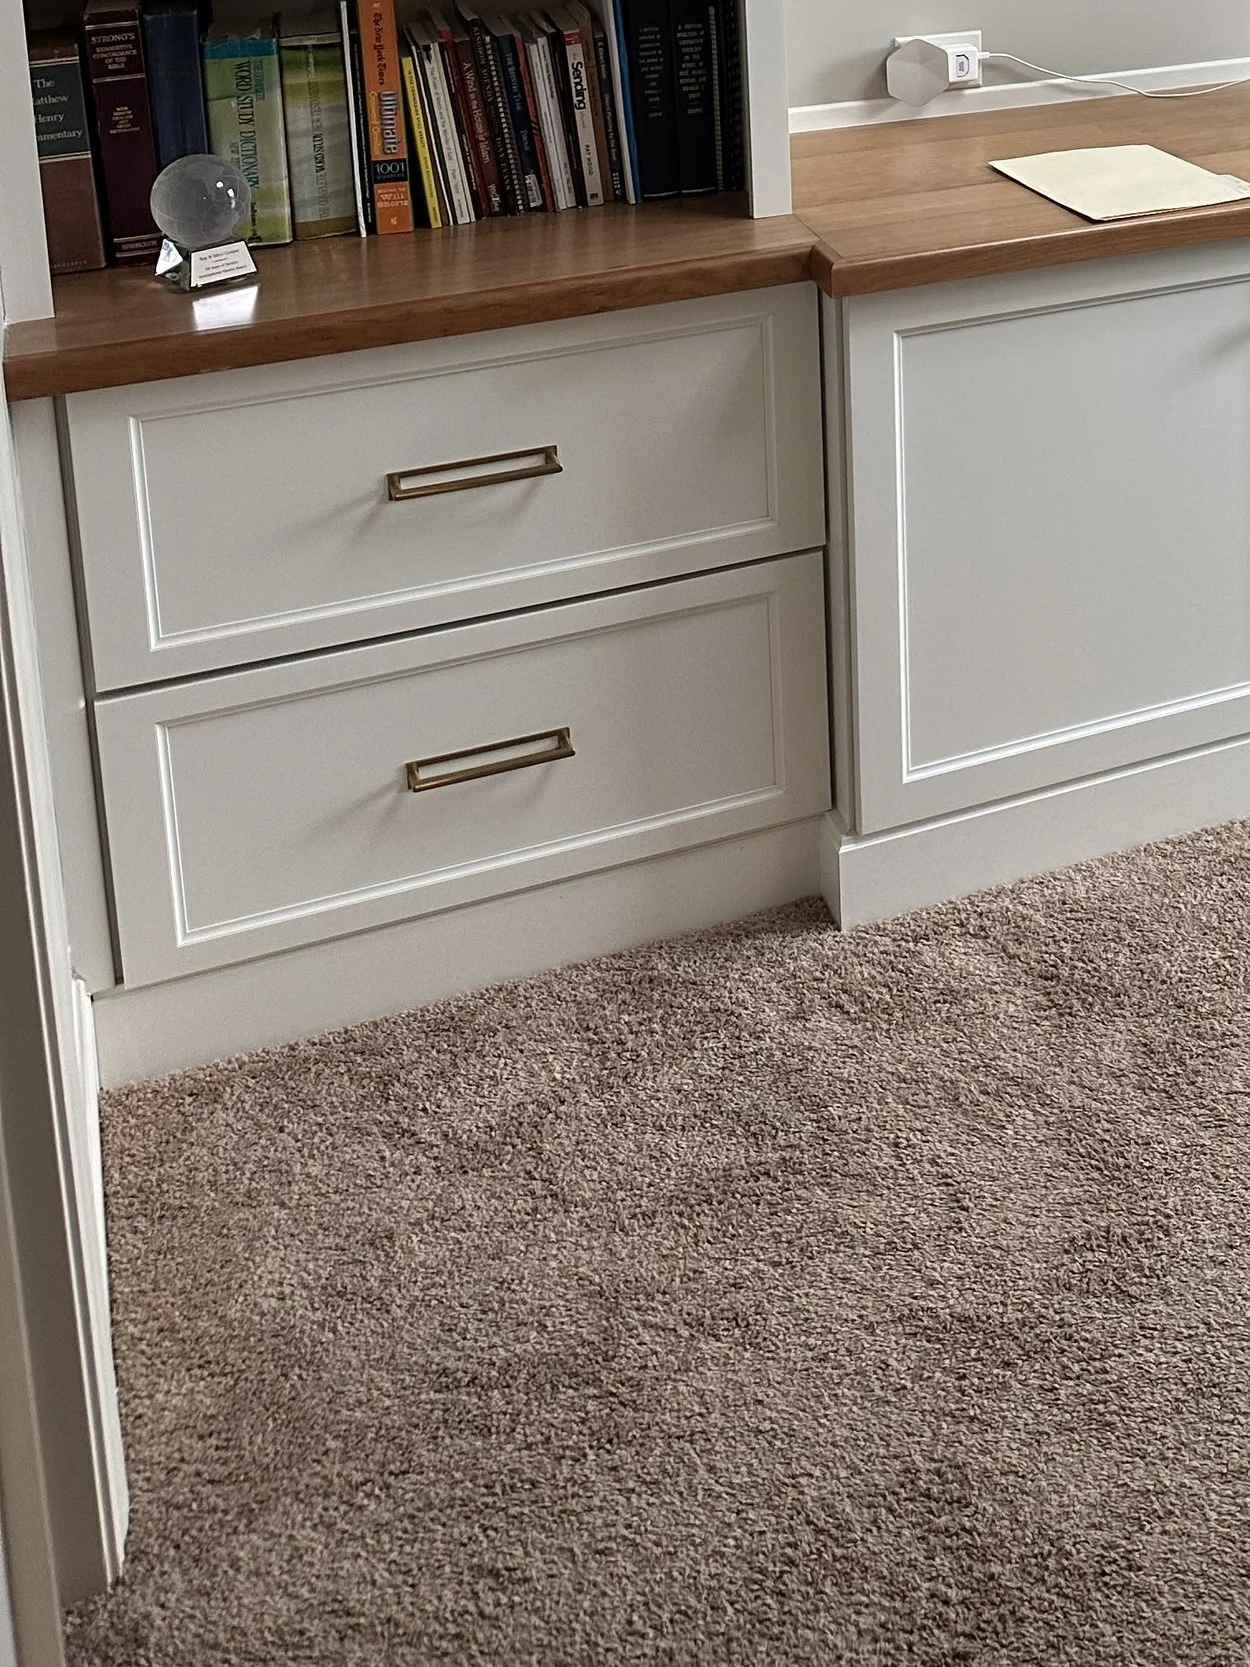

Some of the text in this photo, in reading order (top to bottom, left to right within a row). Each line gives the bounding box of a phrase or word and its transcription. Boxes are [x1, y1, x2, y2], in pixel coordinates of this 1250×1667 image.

[34, 79, 55, 88] The
[571, 61, 587, 111] Sending
[380, 89, 400, 155] Ultimate
[374, 162, 406, 175] 1001
